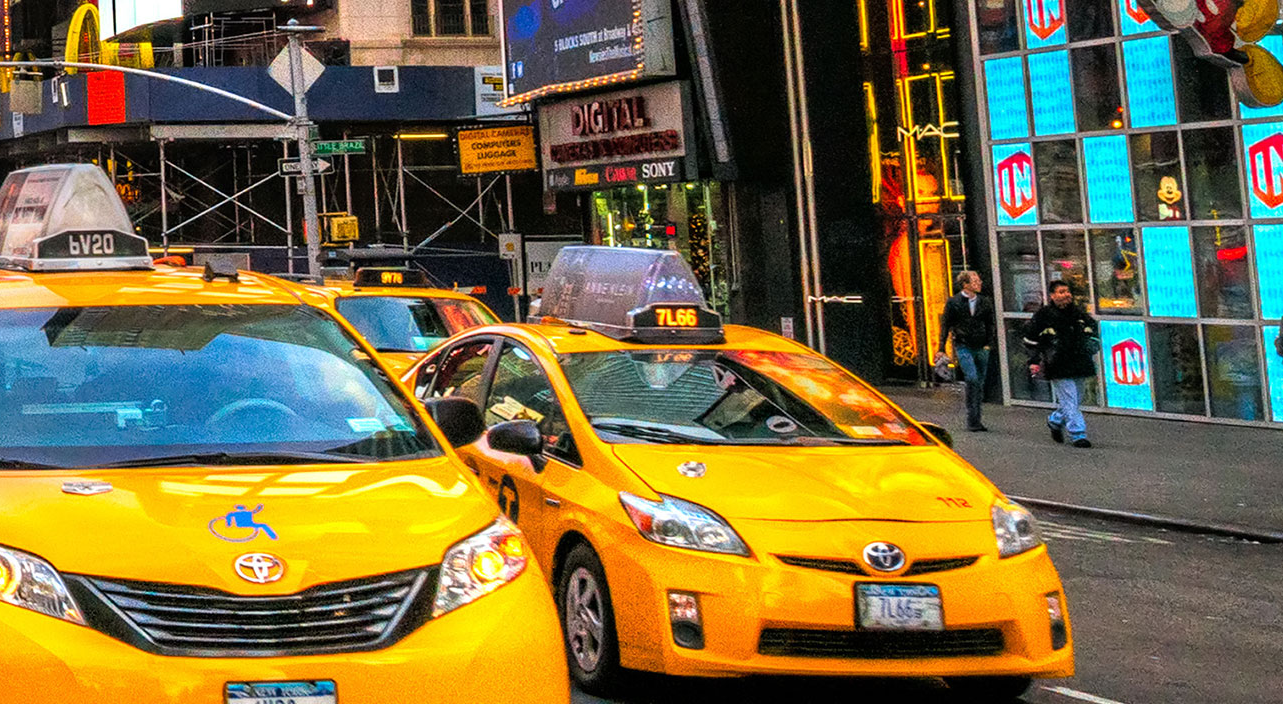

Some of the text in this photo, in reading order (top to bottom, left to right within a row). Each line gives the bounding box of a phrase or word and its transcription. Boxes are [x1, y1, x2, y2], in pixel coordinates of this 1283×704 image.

[571, 96, 651, 136] DIGITAL
[642, 162, 675, 178] SONY
[655, 308, 698, 327] 7L66
